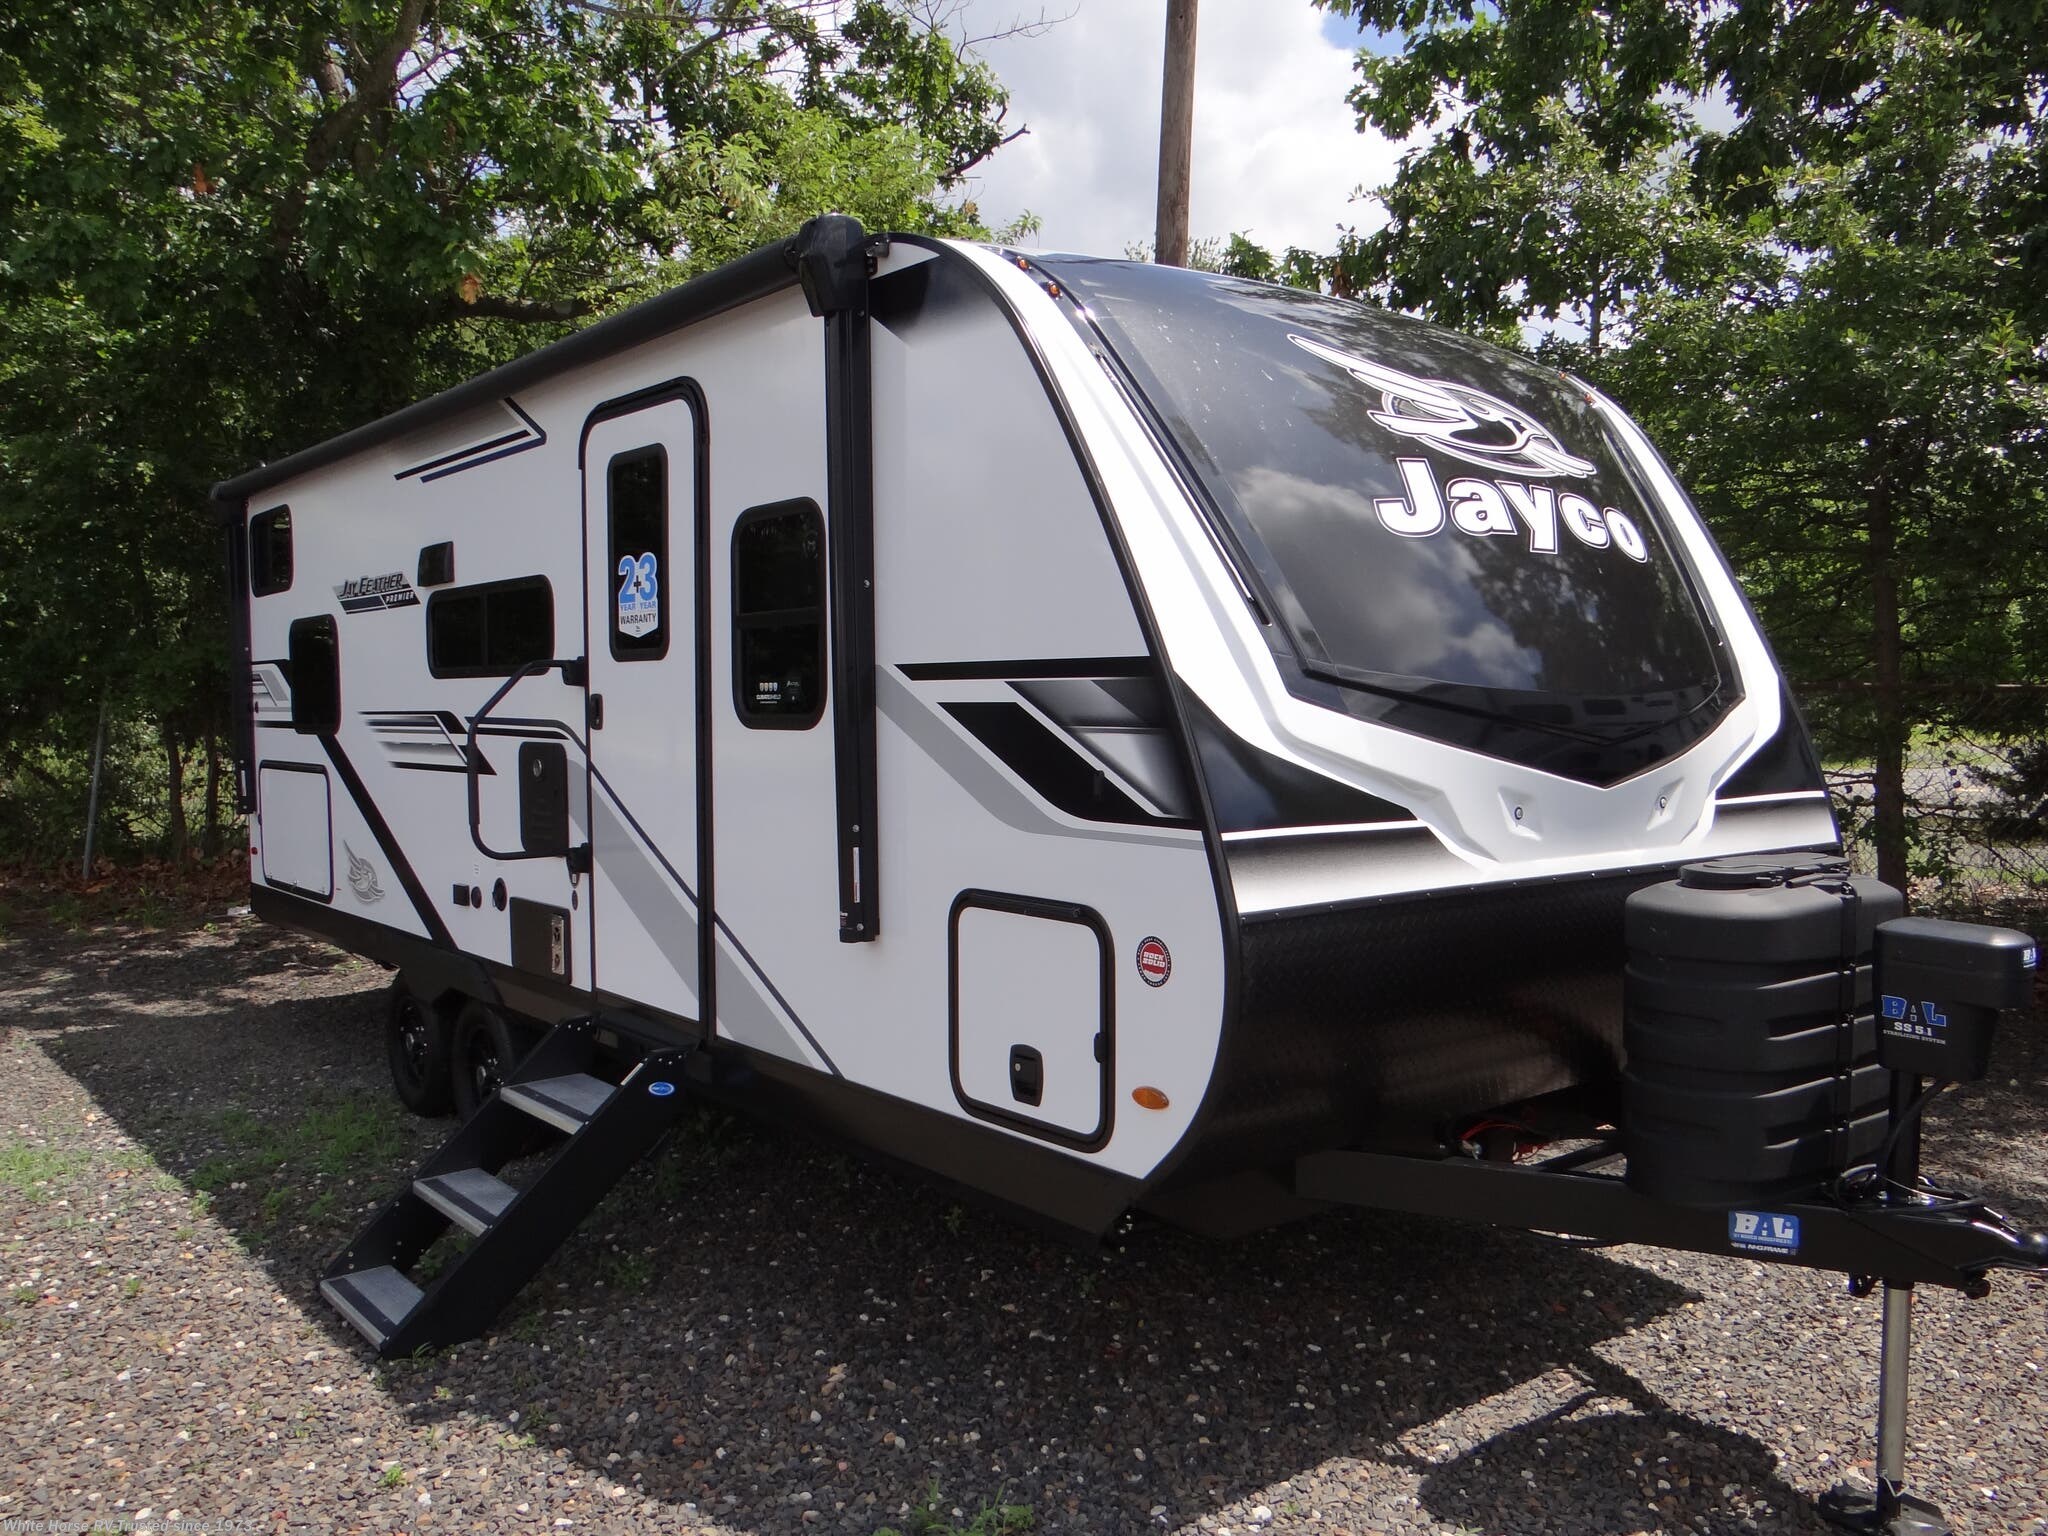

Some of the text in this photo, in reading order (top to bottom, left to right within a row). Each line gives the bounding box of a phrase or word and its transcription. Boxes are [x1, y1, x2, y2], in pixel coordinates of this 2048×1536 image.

[1373, 457, 1648, 563] Jayco
[359, 572, 404, 595] FEATHER
[384, 591, 415, 604] PREMIER
[620, 600, 657, 612] YEAR YEAR
[620, 612, 657, 625] WARRANTY
[1142, 957, 1166, 968] SOLID
[1143, 951, 1165, 962] ROCK
[1881, 994, 1947, 1028] BAL
[1893, 1021, 1913, 1033] SS
[1735, 1212, 1794, 1240] BAL
